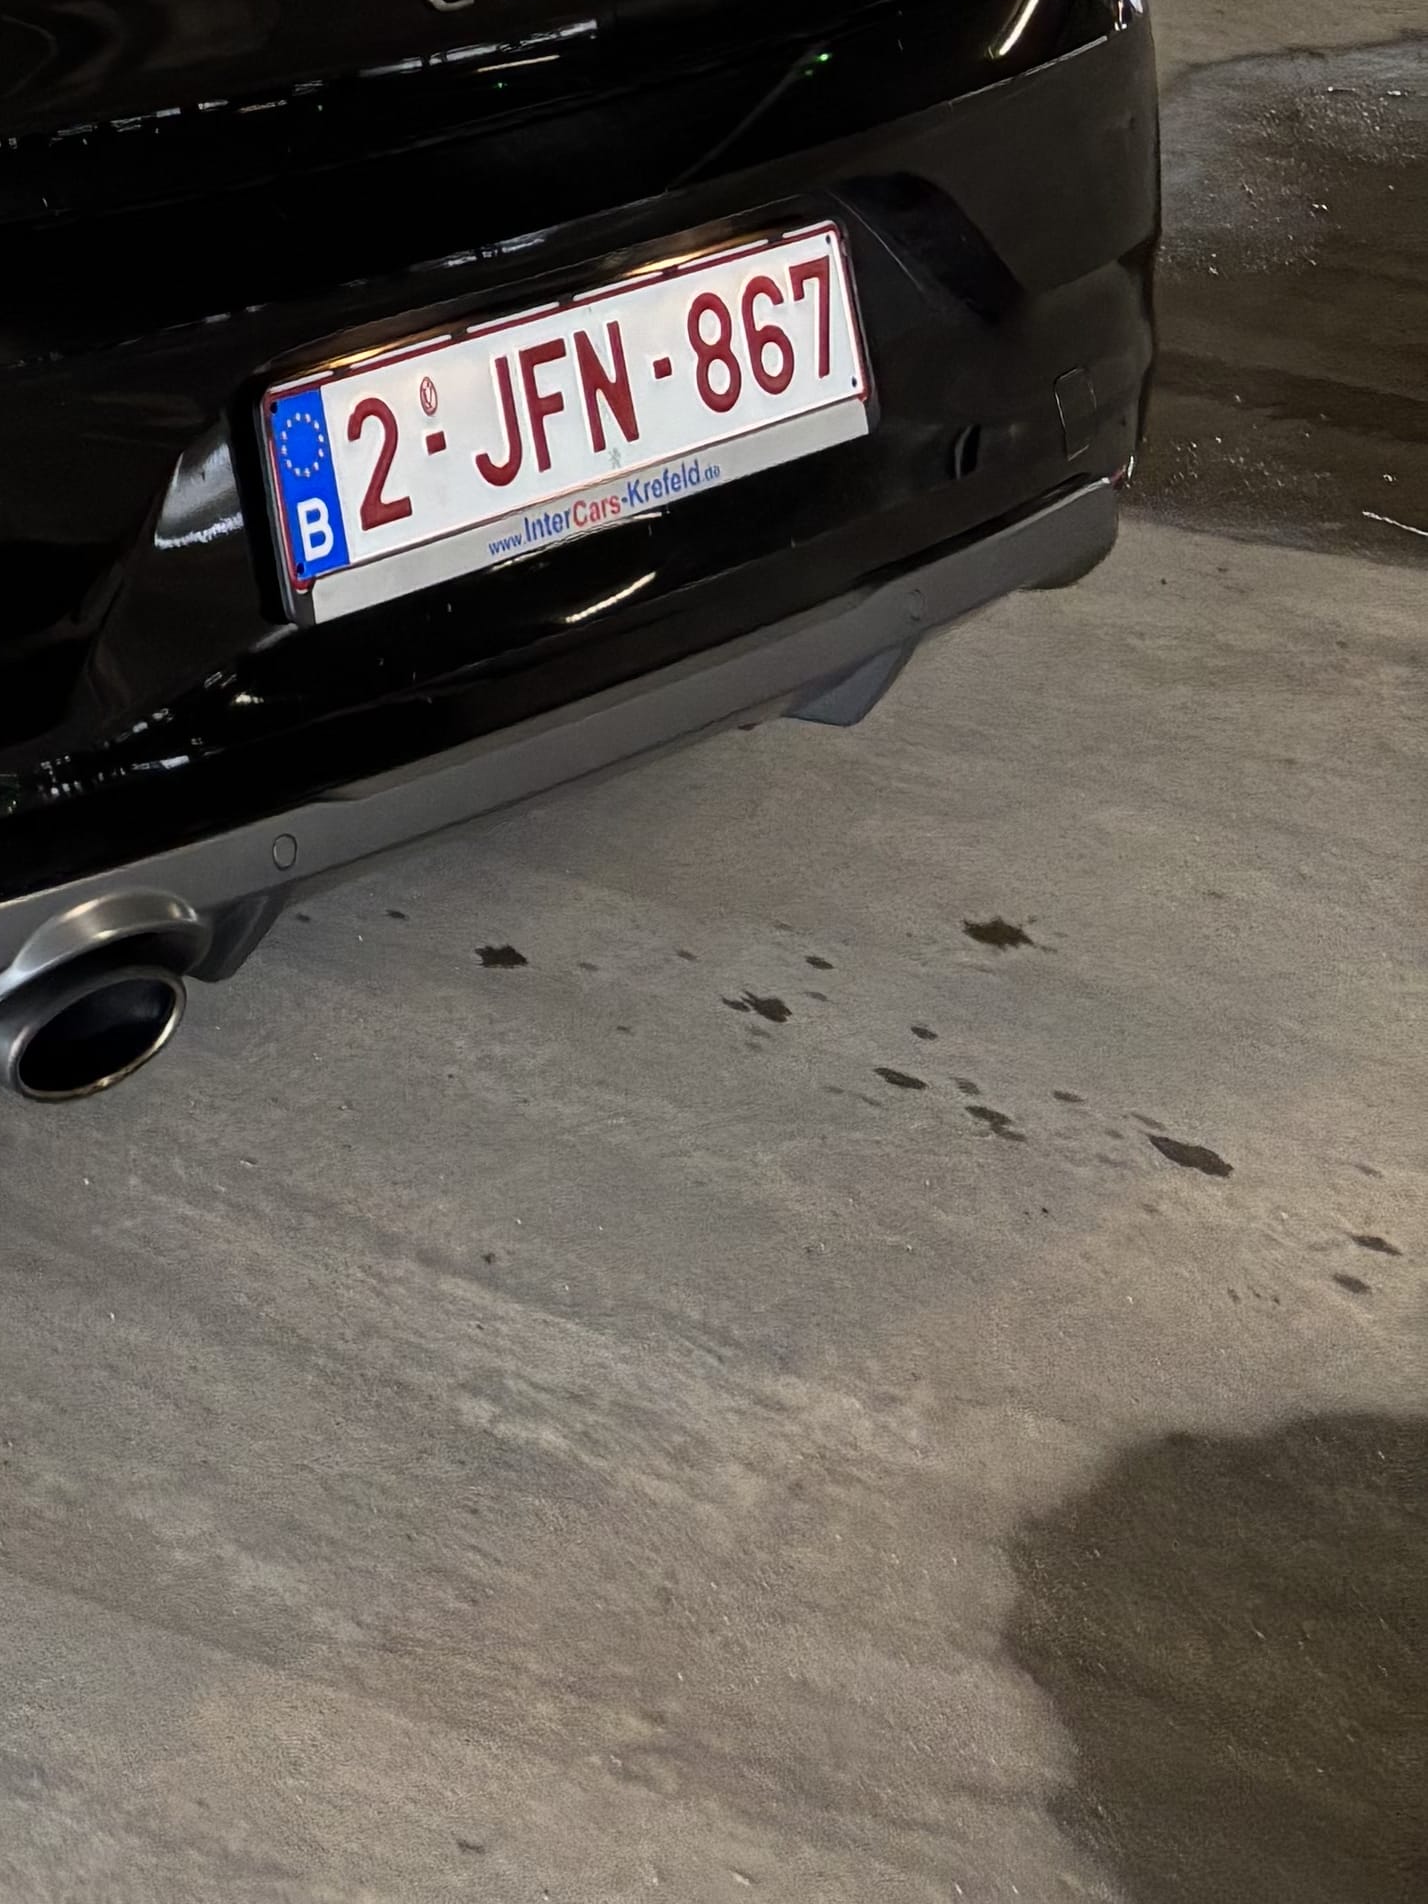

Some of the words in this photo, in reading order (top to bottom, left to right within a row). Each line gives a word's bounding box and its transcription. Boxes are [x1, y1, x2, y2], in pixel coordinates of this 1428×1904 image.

[347, 255, 831, 532] 2-JFN-867
[296, 496, 335, 562] B
[487, 458, 721, 556] www.InterCars-Krefeld.de
